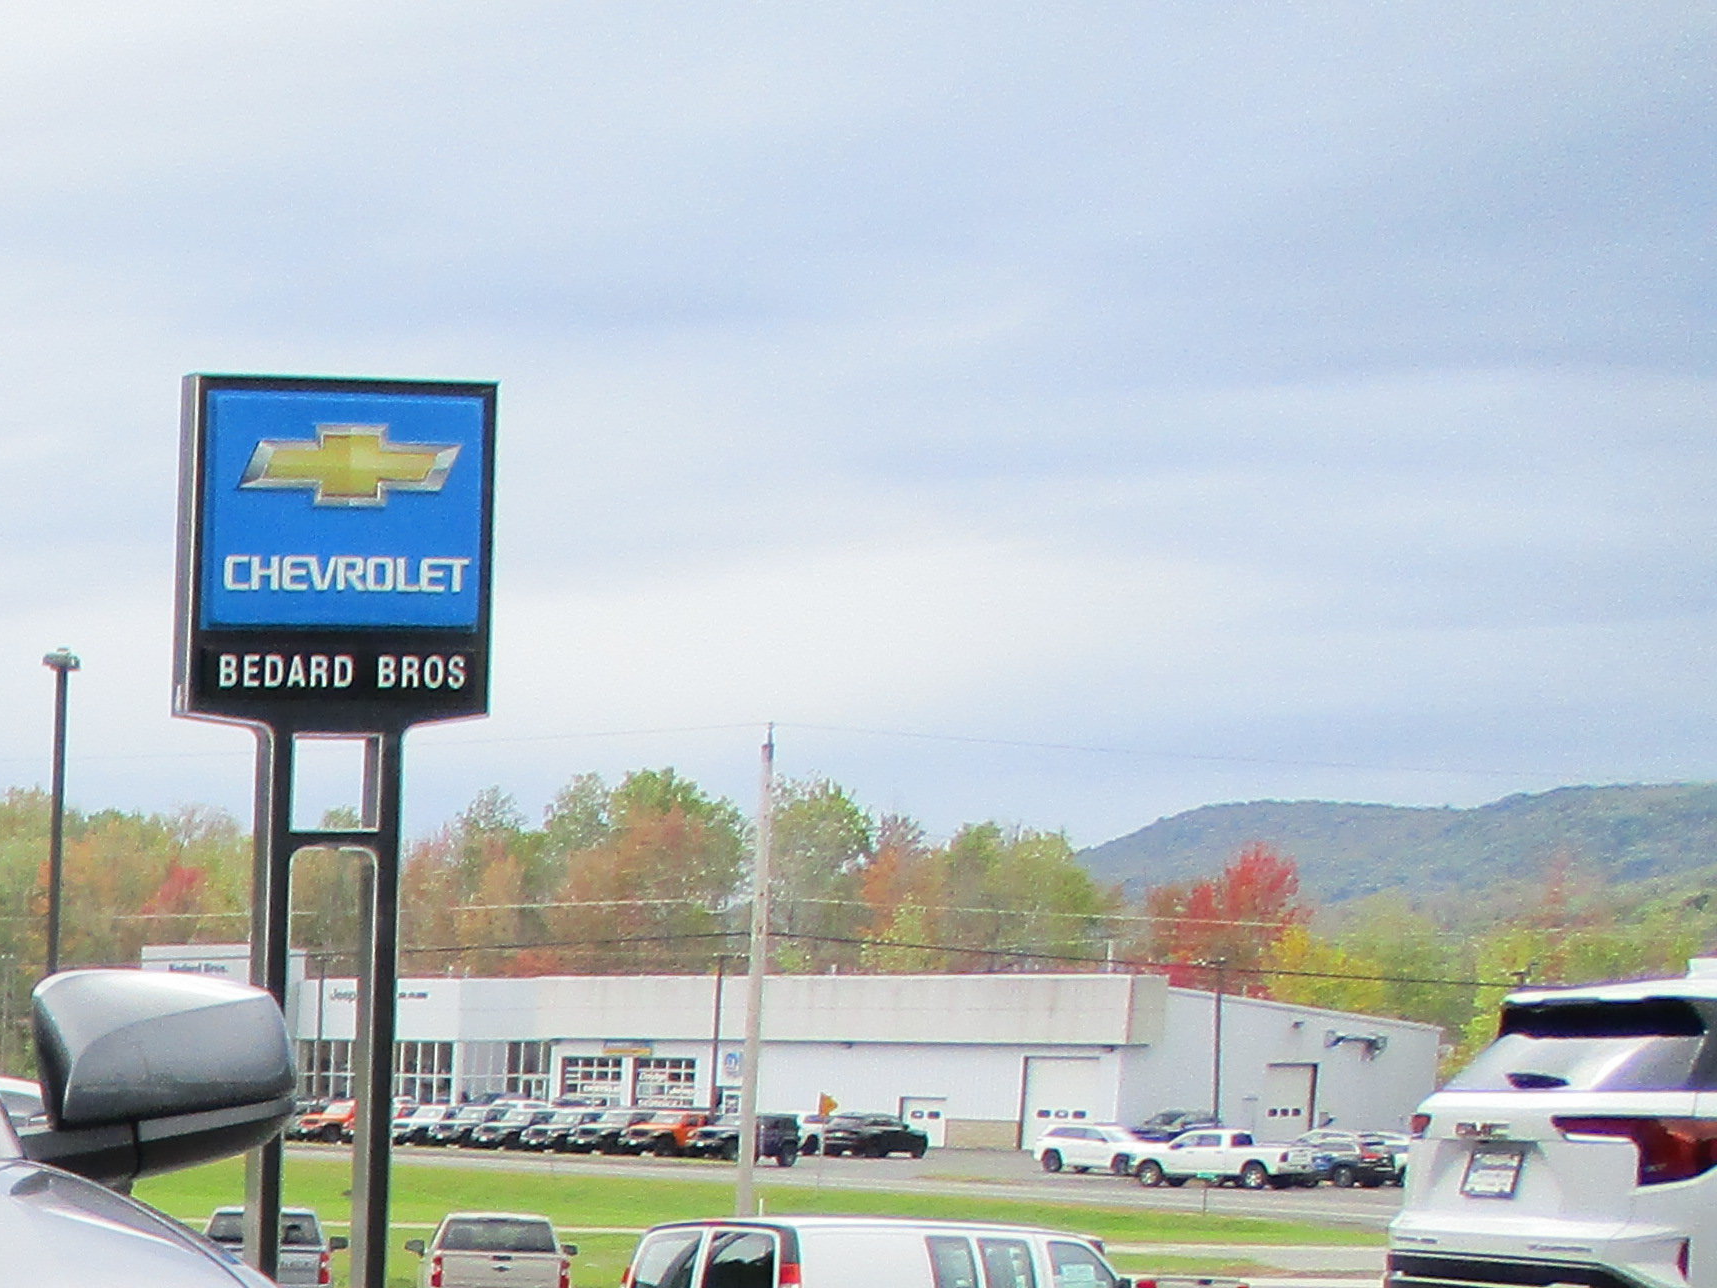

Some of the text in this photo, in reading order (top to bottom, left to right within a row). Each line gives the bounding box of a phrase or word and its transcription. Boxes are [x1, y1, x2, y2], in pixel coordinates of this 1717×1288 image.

[222, 554, 470, 593] CHEVROLET
[218, 653, 466, 690] BEDARD BROS
